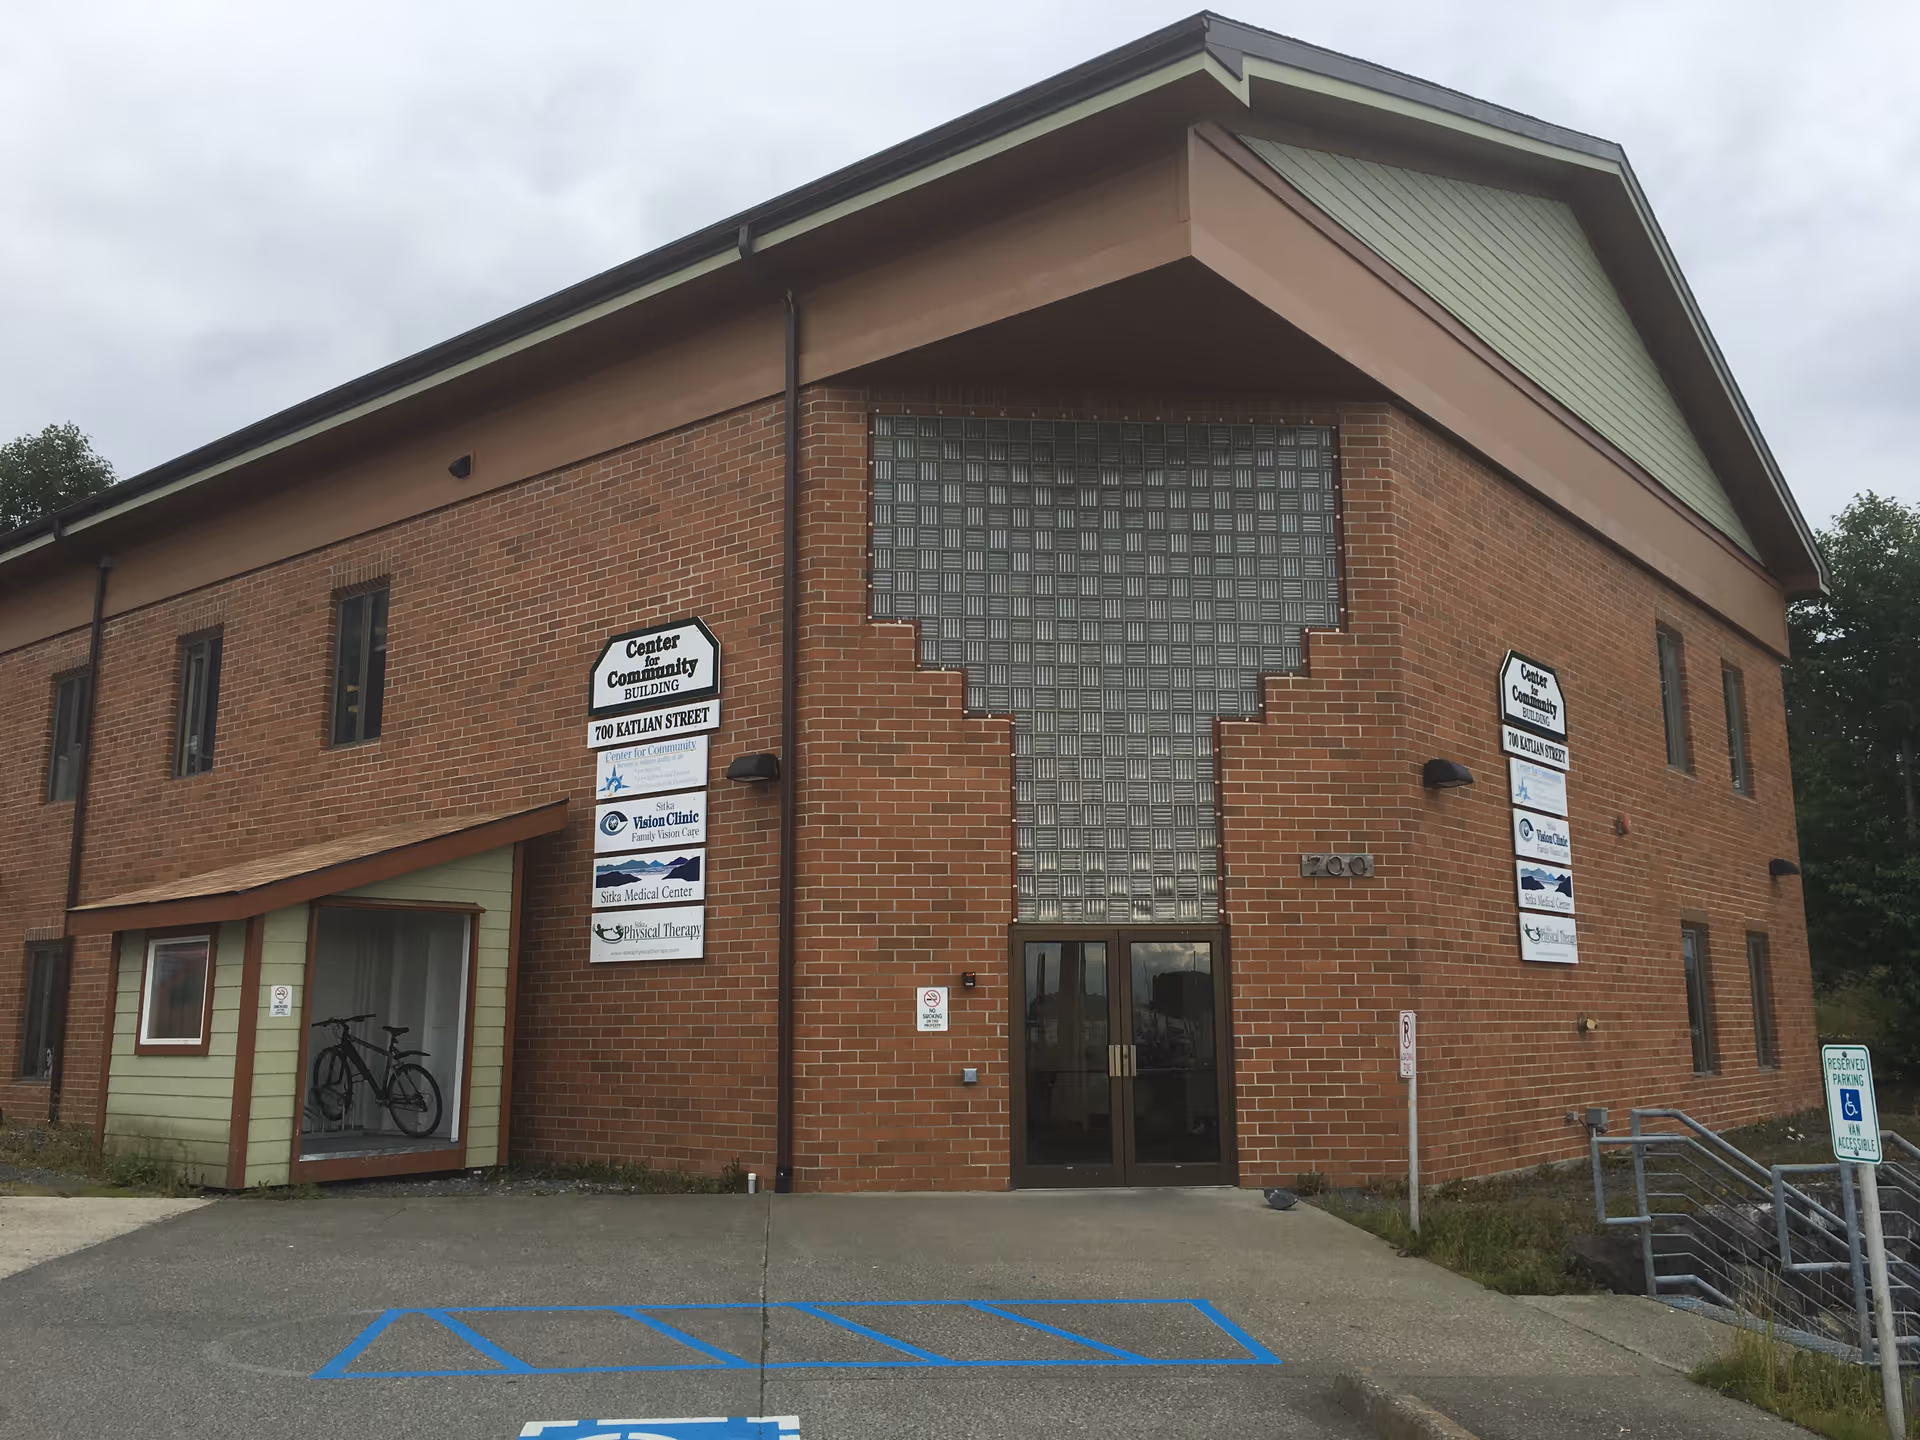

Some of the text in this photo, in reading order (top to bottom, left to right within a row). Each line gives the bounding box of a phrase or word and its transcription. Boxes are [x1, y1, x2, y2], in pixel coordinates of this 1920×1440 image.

[626, 634, 680, 658] Center
[645, 655, 660, 667] for
[607, 657, 698, 688] Community
[1521, 663, 1548, 689] Center
[624, 679, 680, 700] BUILDING
[1531, 684, 1539, 696] for
[1512, 685, 1557, 720] Community
[595, 707, 710, 741] 700 KATLIAN STREET
[1522, 707, 1550, 727] BUILDING
[605, 750, 632, 763] Center
[634, 747, 647, 758] for
[648, 740, 696, 756] Community
[1508, 731, 1565, 763] 700 KATLIAN STREET
[656, 801, 675, 812] Sitka
[633, 810, 699, 830] Vision Clinic
[631, 827, 700, 842] Family Vision Care
[1536, 829, 1553, 844] Vision
[1307, 855, 1366, 876] 700
[600, 885, 693, 904] Sitka Medical Center
[624, 922, 702, 943] Physical Therapy
[1827, 1058, 1866, 1071] RESERVED
[1832, 1073, 1864, 1087] PARKING
[1848, 1123, 1861, 1136] VAN
[1838, 1136, 1876, 1152] ACCESSIBLE
